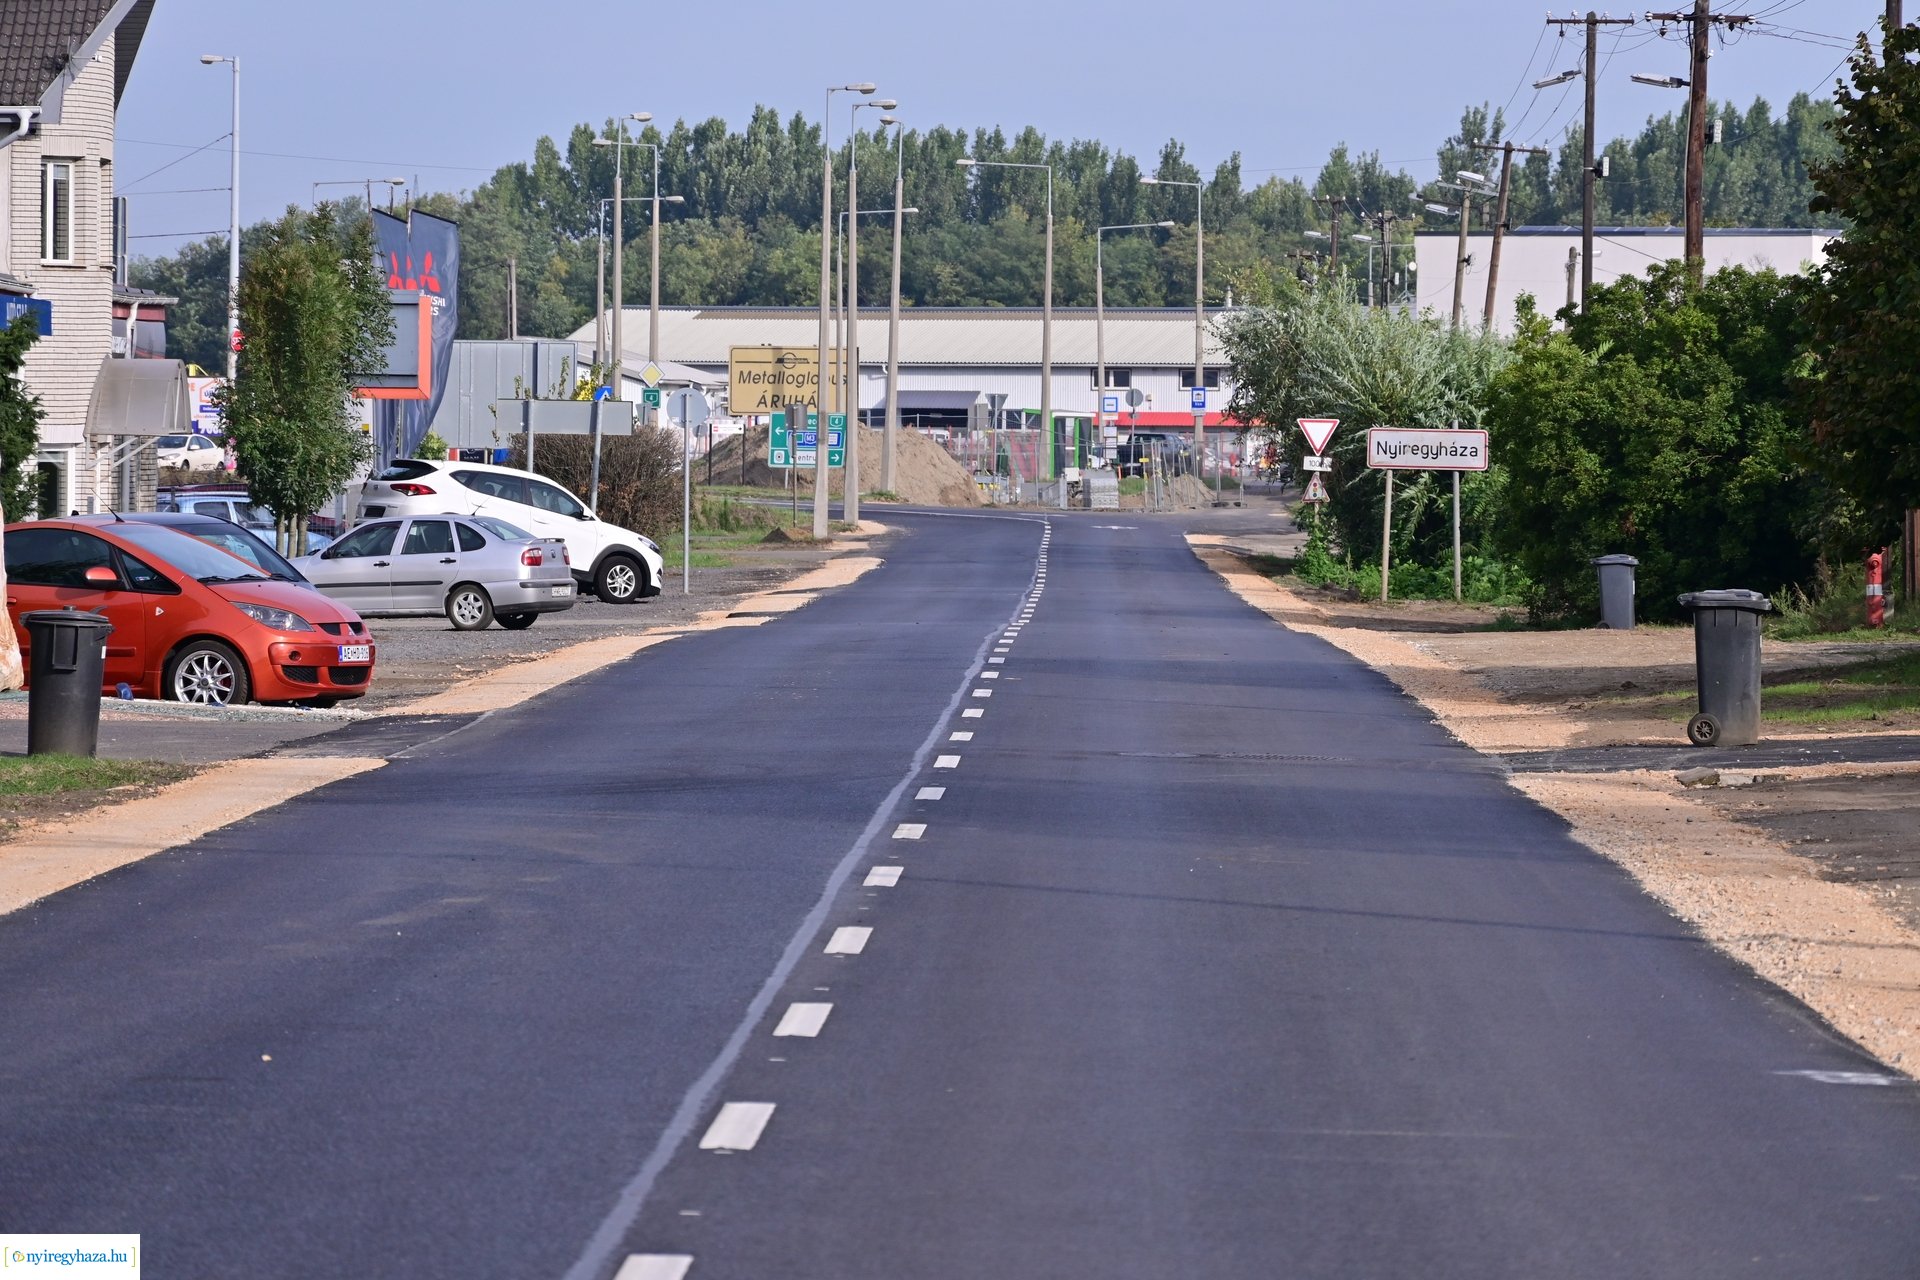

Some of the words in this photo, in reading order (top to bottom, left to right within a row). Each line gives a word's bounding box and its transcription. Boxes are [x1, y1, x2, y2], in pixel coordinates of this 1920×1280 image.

[738, 370, 848, 388] Metalloglous
[756, 390, 817, 408] ÁRUHÁ
[797, 452, 816, 461] entru
